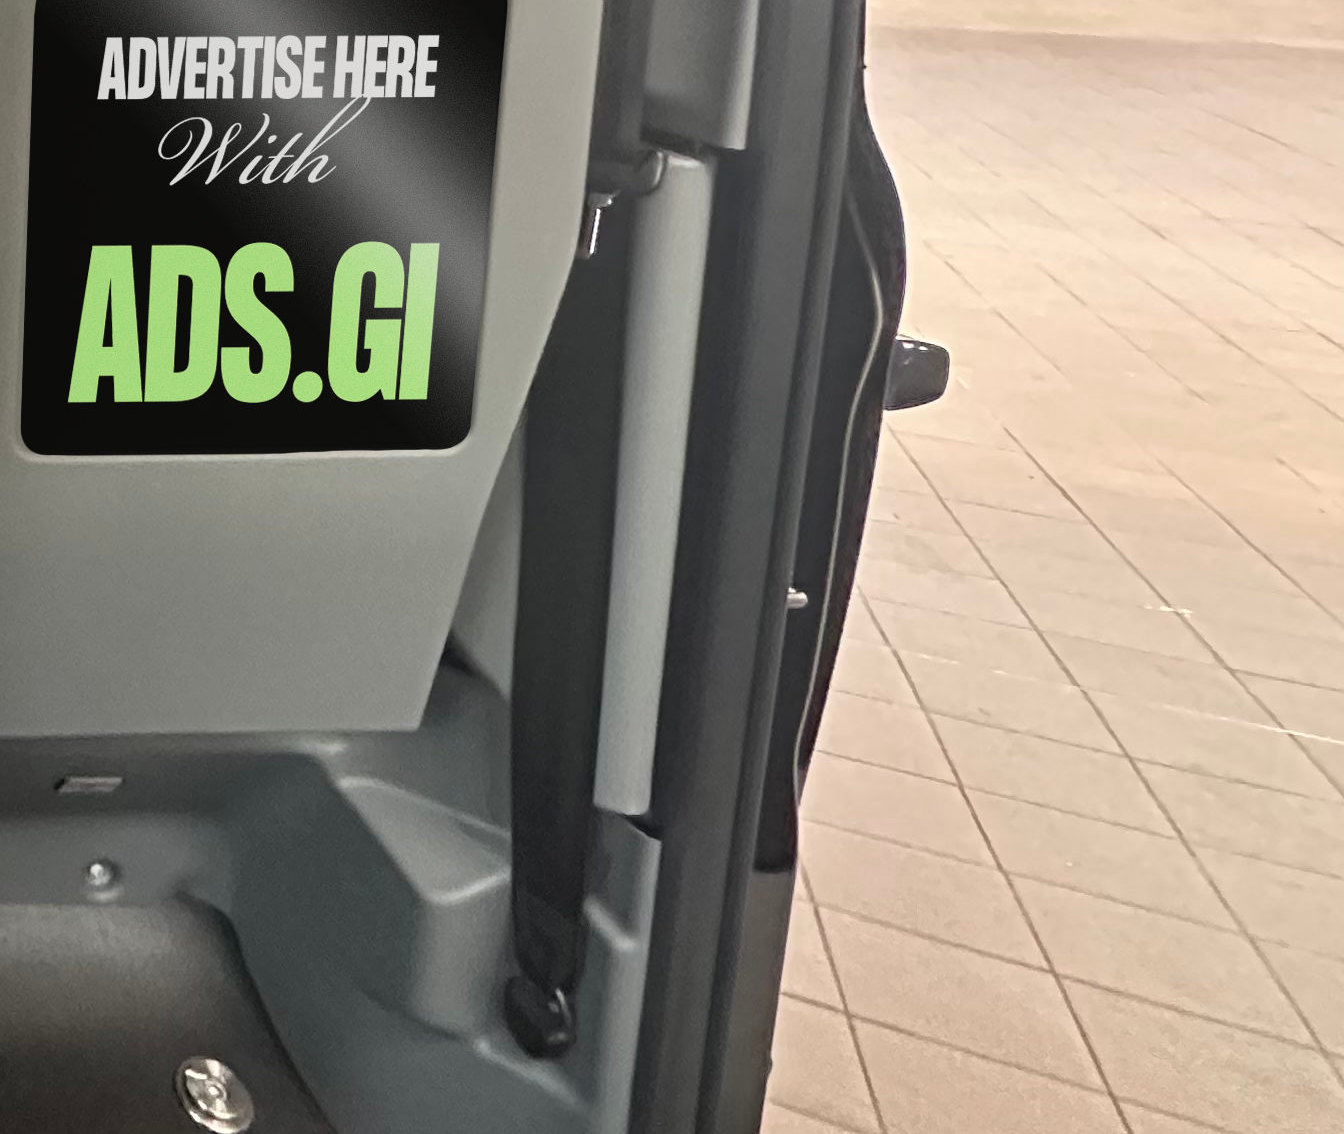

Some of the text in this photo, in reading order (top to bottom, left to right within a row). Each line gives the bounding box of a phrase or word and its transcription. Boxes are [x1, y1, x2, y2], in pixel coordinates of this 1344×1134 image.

[96, 34, 440, 101] ADVERTISE HERE
[156, 92, 373, 187] With
[66, 241, 441, 404] ADS.GI
